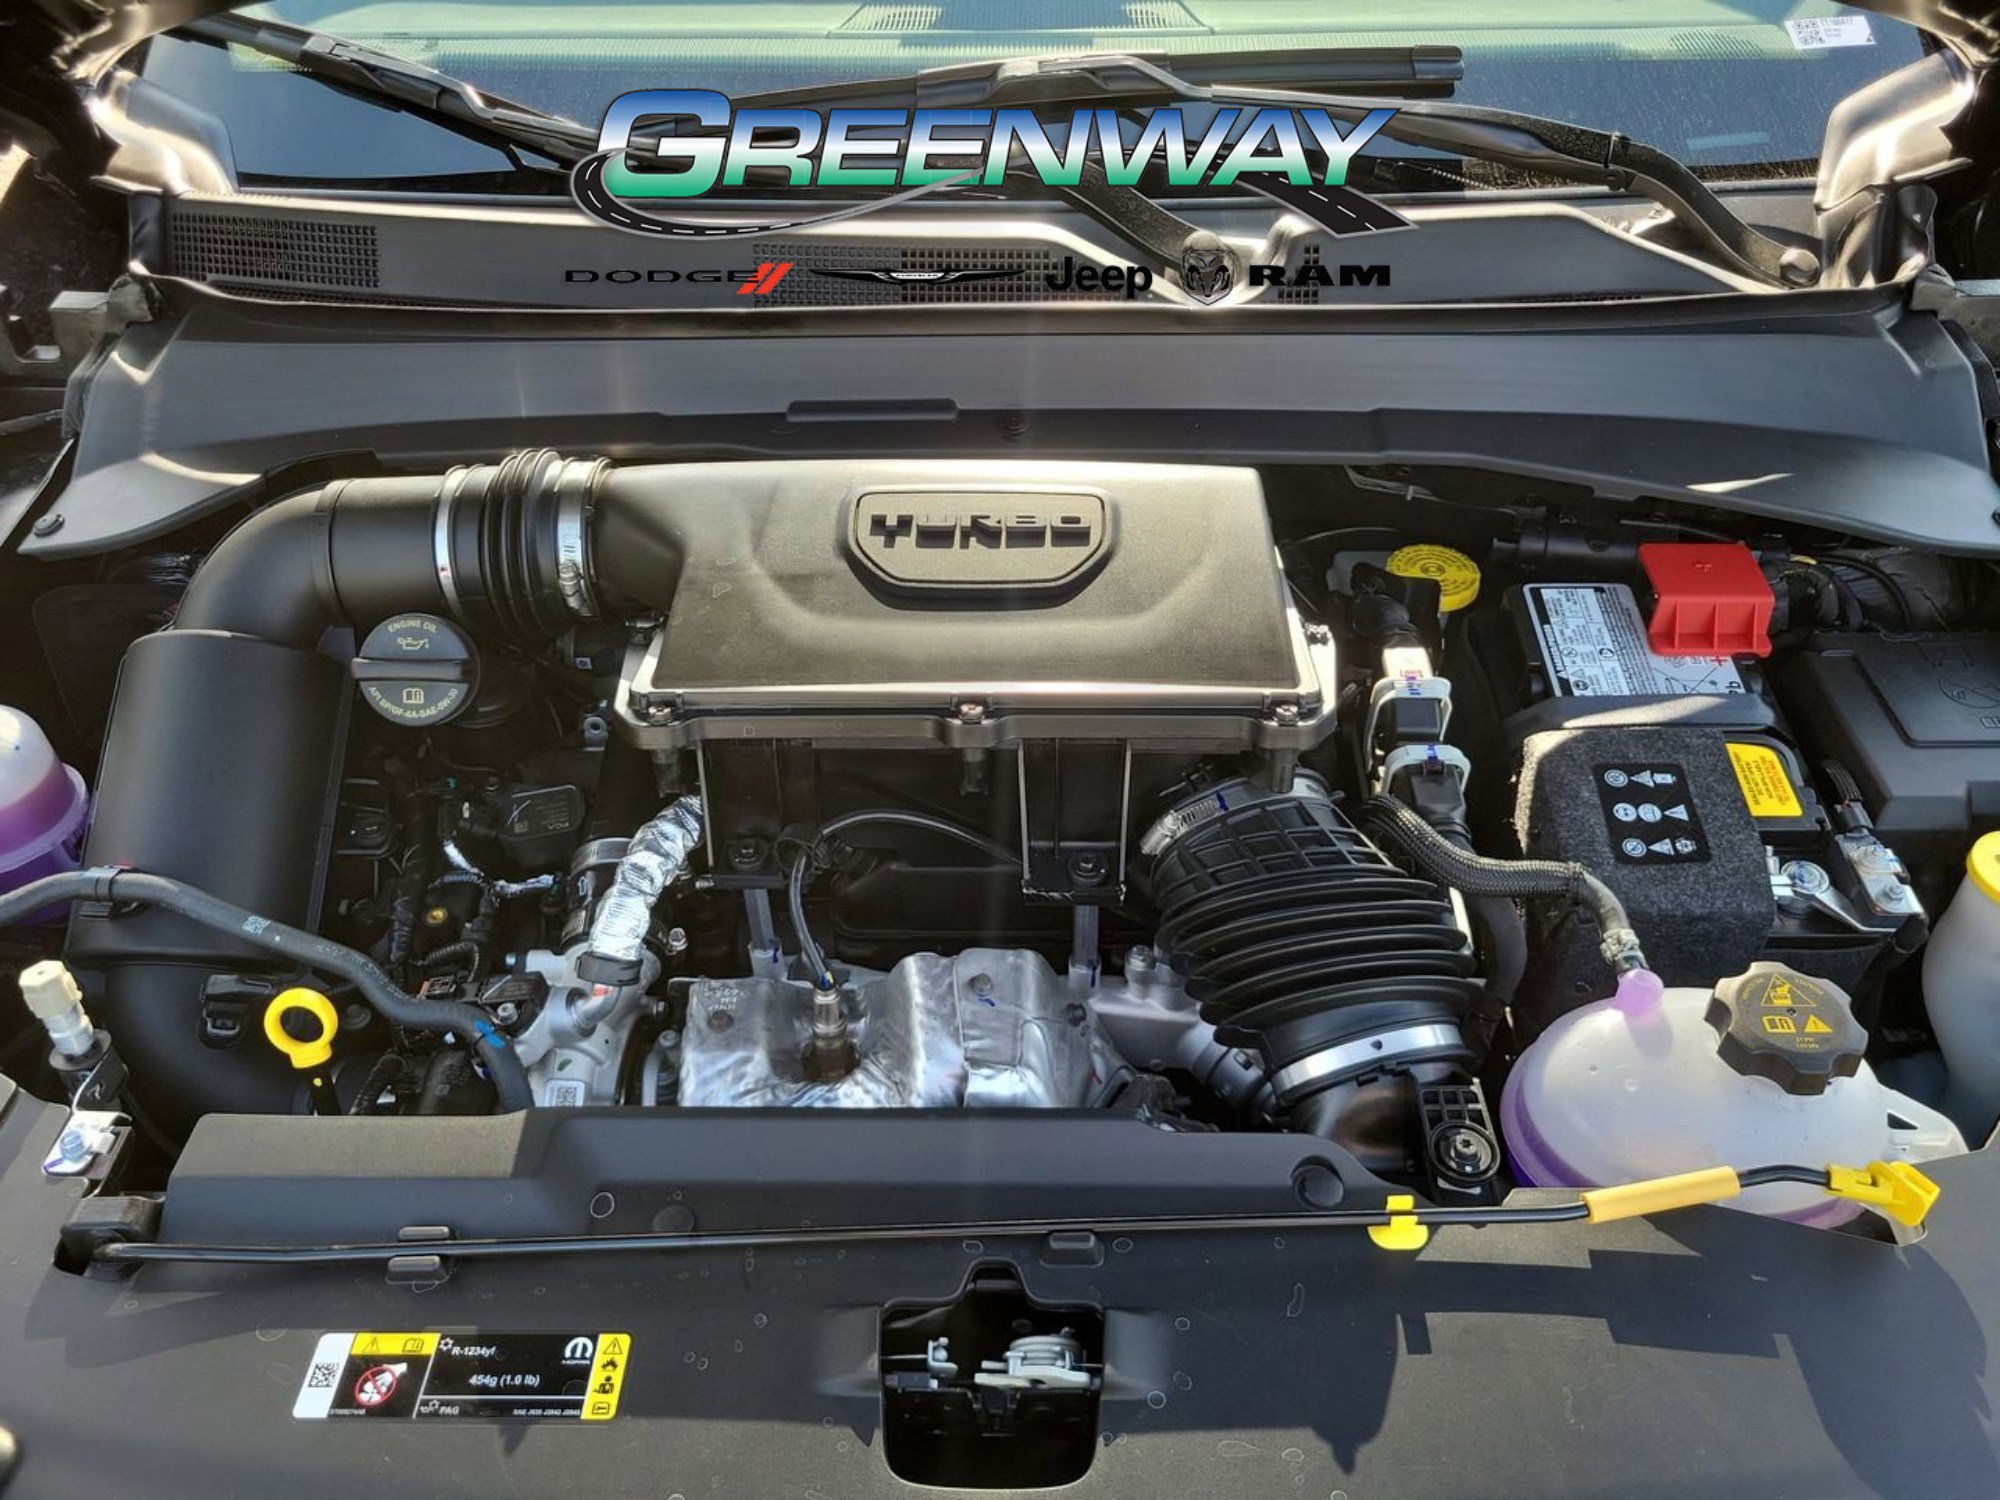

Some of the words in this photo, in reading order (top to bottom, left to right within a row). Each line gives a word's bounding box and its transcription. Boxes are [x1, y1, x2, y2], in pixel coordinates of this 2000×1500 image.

[869, 513, 1092, 550] TURBO
[388, 619, 421, 633] ENGINE
[423, 621, 437, 634] OIL
[451, 1346, 497, 1357] R-1234yf
[468, 1374, 498, 1387] 454g
[500, 1374, 522, 1388] (1.0
[524, 1374, 541, 1388] lb)
[439, 1405, 460, 1415] PAG
